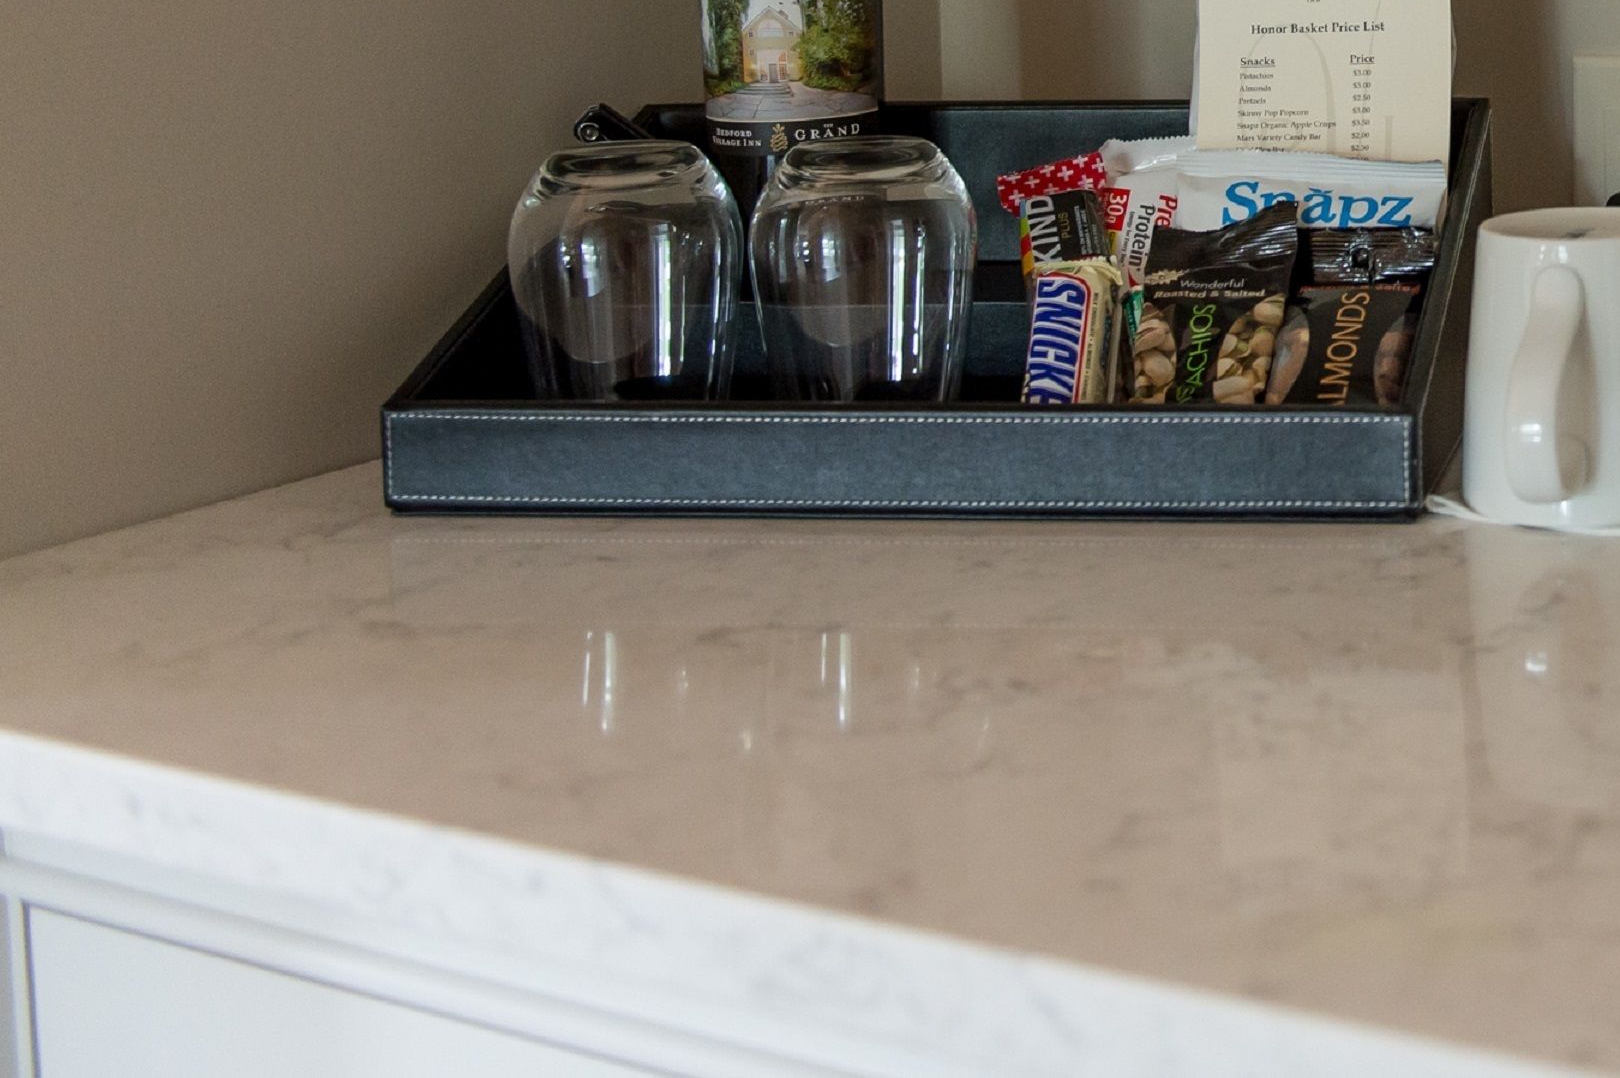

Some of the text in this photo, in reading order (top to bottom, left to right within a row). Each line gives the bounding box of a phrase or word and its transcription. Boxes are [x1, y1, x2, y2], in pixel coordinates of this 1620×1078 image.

[1251, 21, 1385, 34] Honor Basket Price List
[1240, 53, 1376, 67] Snacks Price
[1238, 109, 1261, 117] Skinny
[1264, 109, 1278, 118] Pop
[1280, 109, 1309, 118] Popcorn
[795, 123, 860, 141] GRAND
[1290, 121, 1312, 130] Apple
[716, 127, 752, 138] BEDFORD
[1284, 133, 1307, 141] Candy
[713, 135, 762, 147] VILLAGE INN
[1155, 194, 1178, 229] Pre
[1026, 195, 1063, 263] KIND
[1057, 211, 1071, 239] PLUS
[1128, 204, 1156, 267] Protein
[1180, 278, 1245, 289] Wonderful
[1154, 290, 1207, 299] Roasted
[1224, 289, 1266, 298] Salted
[1316, 292, 1370, 405] LMONDS
